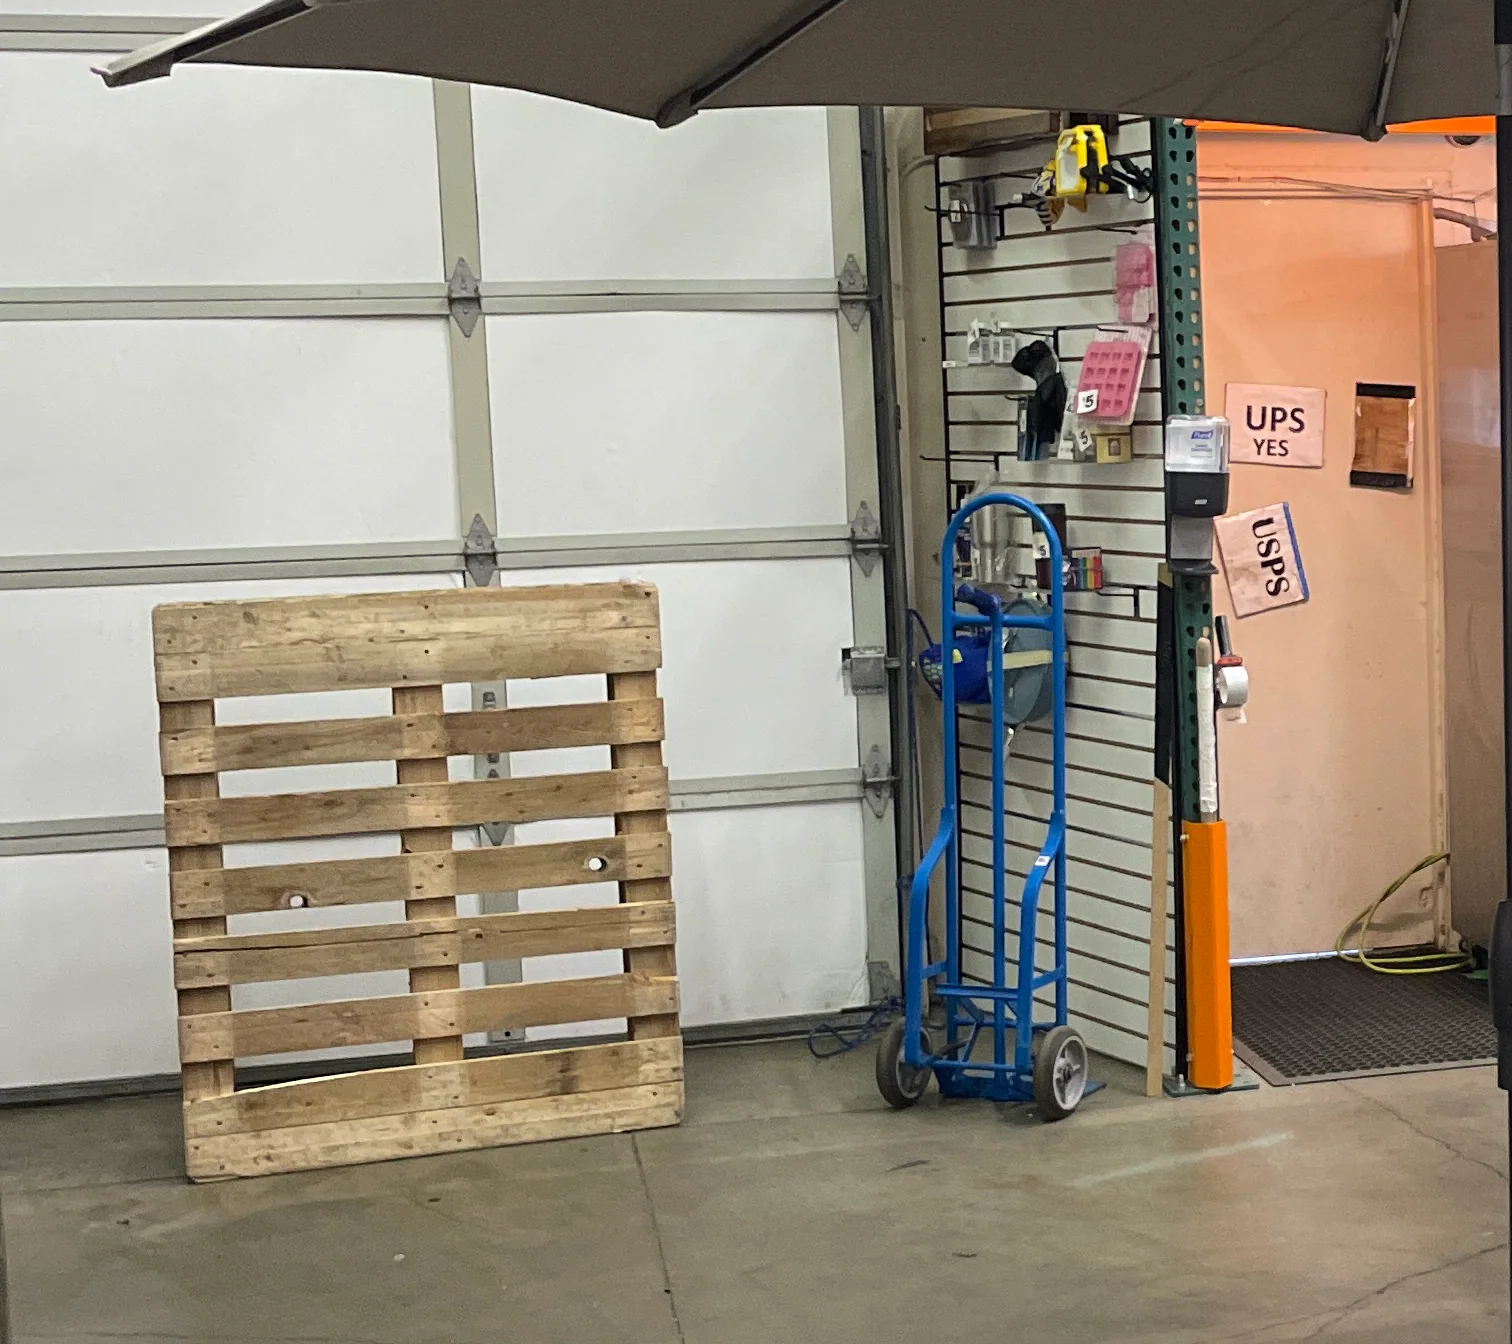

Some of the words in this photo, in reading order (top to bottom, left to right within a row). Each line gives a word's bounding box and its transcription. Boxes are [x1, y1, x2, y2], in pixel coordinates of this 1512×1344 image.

[1246, 405, 1306, 434] UPS
[1253, 438, 1290, 457] YES
[1252, 516, 1290, 597] USPS
